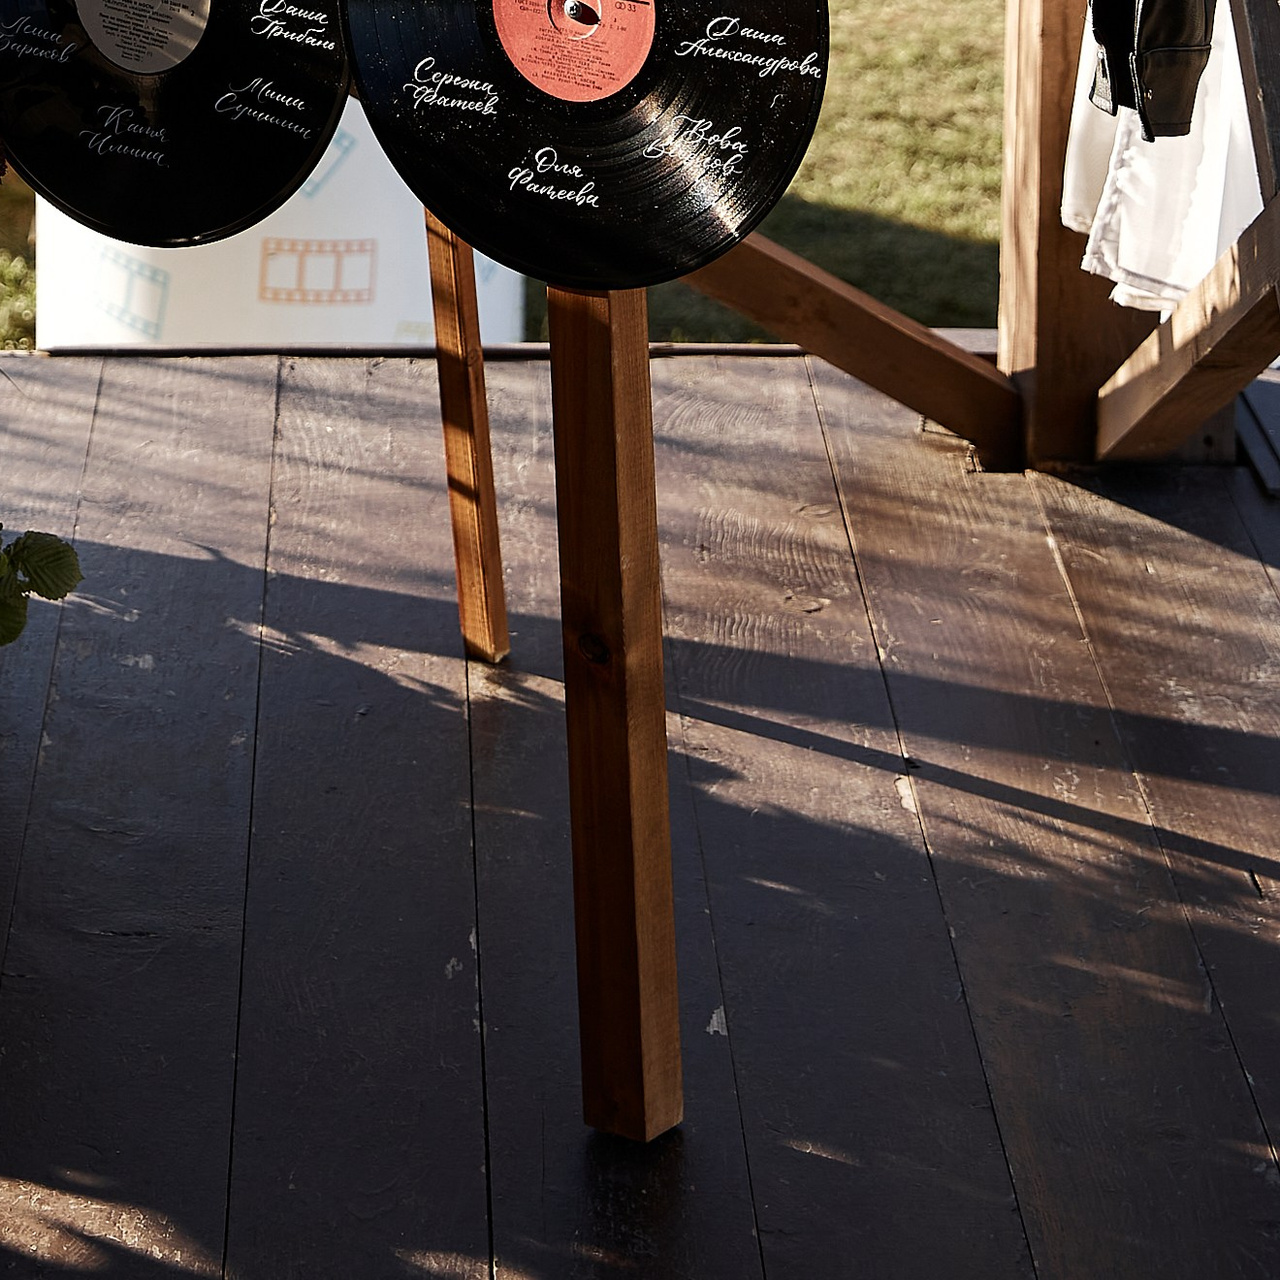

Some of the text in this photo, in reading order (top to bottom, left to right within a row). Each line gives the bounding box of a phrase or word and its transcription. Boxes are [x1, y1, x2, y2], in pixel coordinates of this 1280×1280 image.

[706, 16, 787, 47] Даша
[674, 38, 822, 79] Александрова
[403, 83, 499, 116] Фатеев
[672, 115, 748, 154] Вова
[535, 147, 583, 178] Оля
[508, 167, 599, 208] Фатеева
